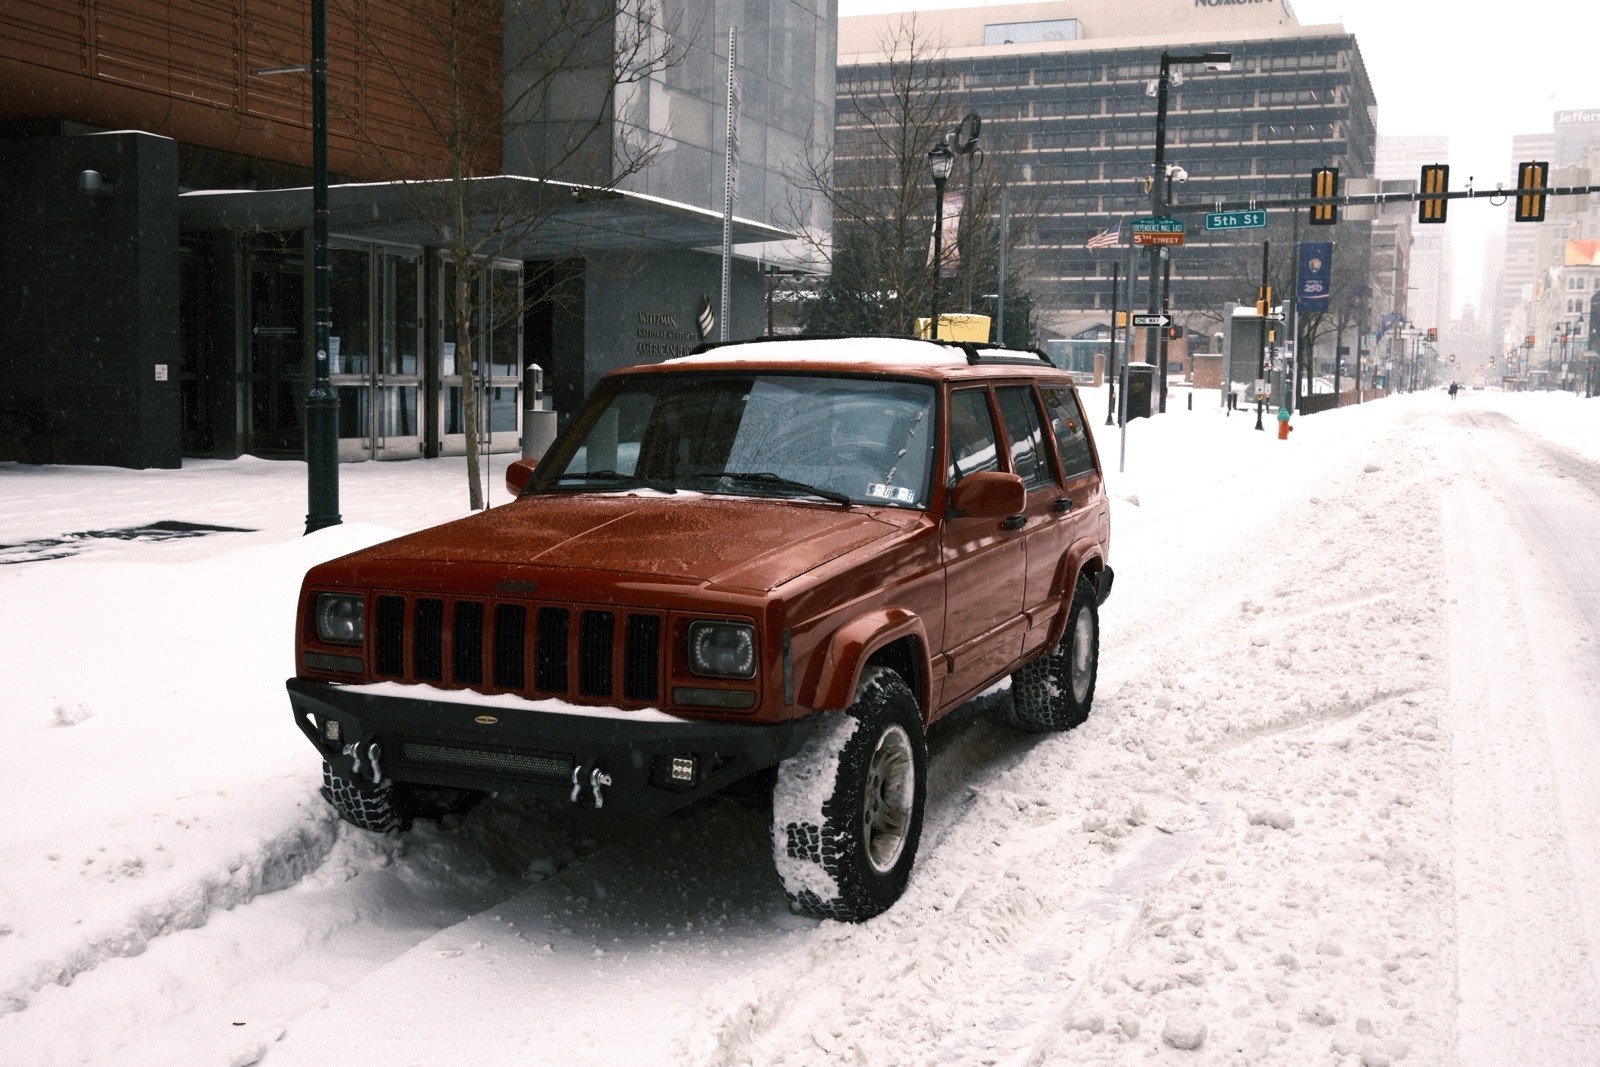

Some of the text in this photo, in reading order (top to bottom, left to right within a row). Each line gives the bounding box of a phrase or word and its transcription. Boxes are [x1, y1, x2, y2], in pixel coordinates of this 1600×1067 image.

[1213, 214, 1259, 227] 5th St
[1172, 223, 1183, 232] EAST
[1133, 234, 1152, 243] 5TH
[639, 312, 676, 326] WEITZMAN
[637, 343, 676, 356] AMERICAN
